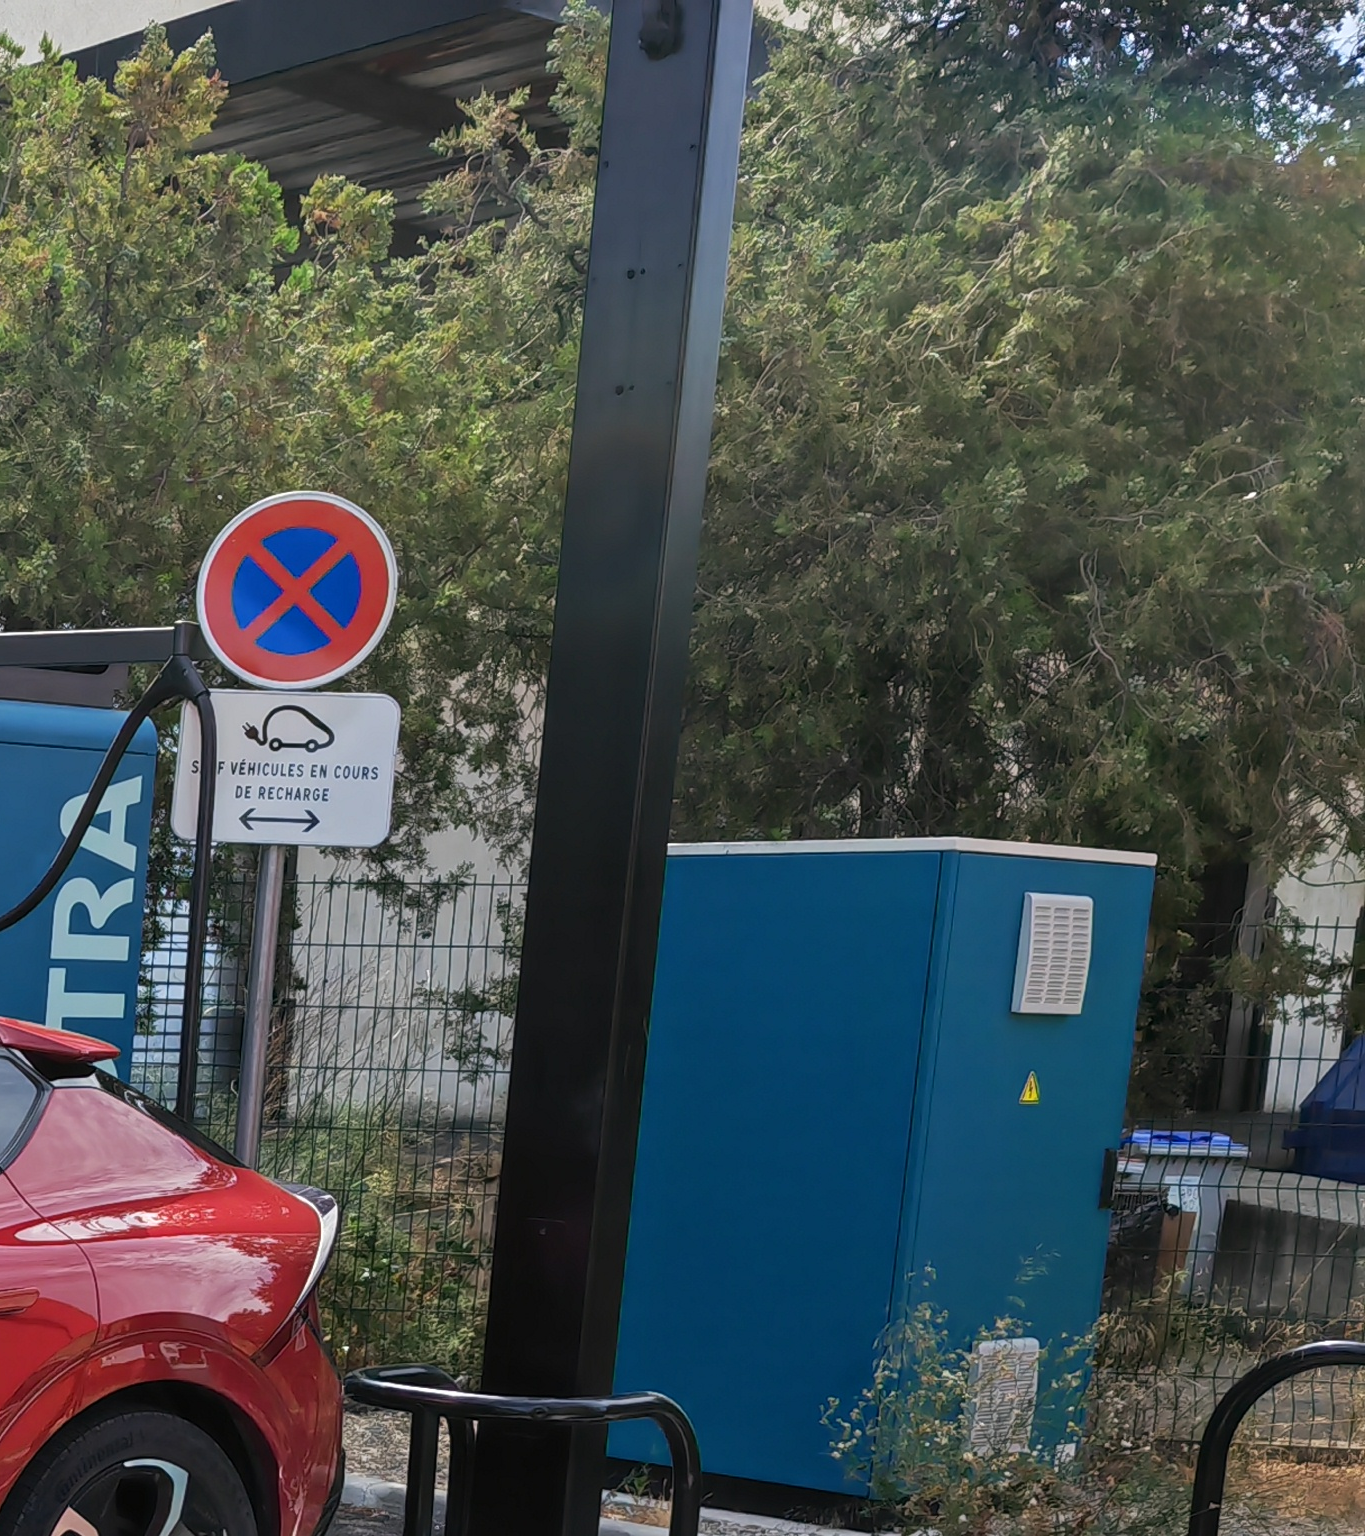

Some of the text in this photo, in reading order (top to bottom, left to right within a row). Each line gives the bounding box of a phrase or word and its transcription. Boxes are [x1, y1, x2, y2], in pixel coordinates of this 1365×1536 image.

[191, 759, 379, 780] SF VÉHICULES EN COURS
[235, 785, 330, 802] DE RECHARGE
[45, 774, 143, 1080] TRA
